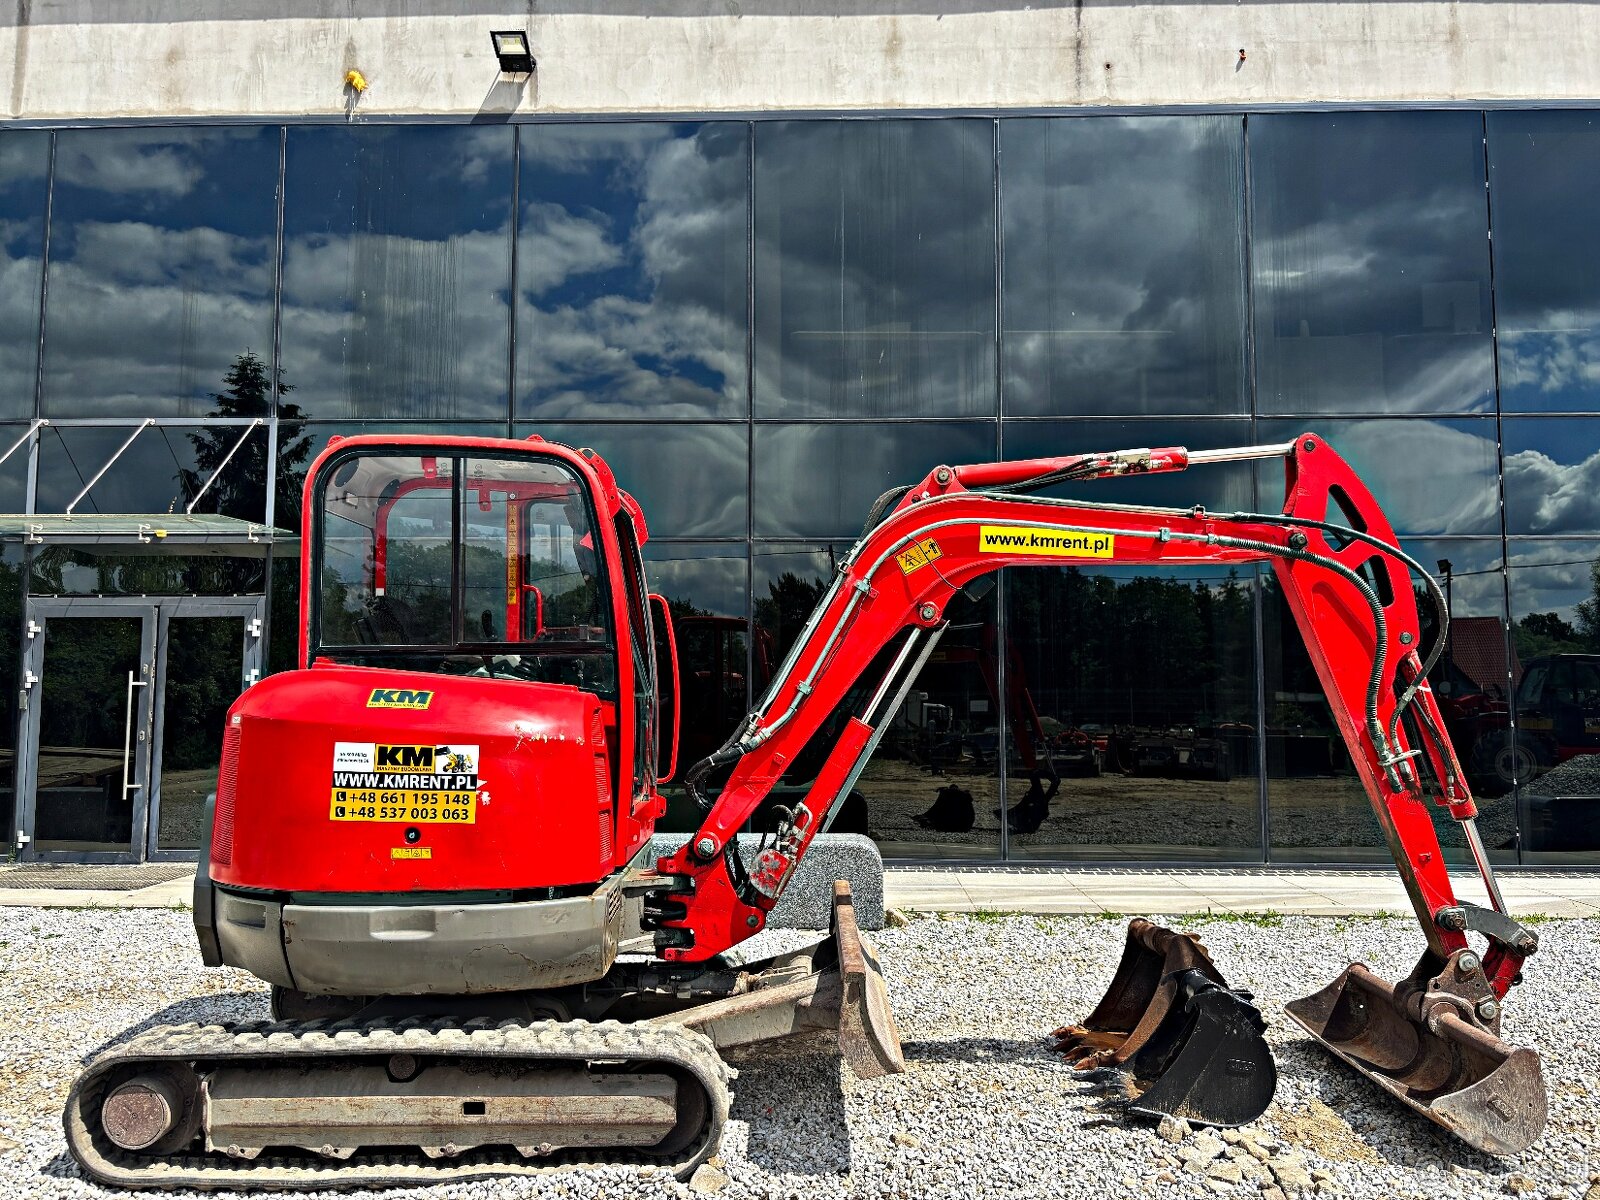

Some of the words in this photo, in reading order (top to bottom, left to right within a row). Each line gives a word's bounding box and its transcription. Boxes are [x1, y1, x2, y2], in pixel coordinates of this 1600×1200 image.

[985, 533, 1109, 553] www.kmrent.pl
[371, 689, 431, 704] KM
[377, 746, 433, 766] KM
[334, 772, 475, 789] WWW.KMRENT.PL
[349, 792, 376, 803] +48
[380, 792, 406, 804] 661
[412, 793, 438, 805] 195
[444, 793, 470, 805] 148
[348, 806, 376, 818] +48
[380, 807, 406, 819] 537
[411, 807, 437, 819] 003
[442, 808, 469, 820] 063
